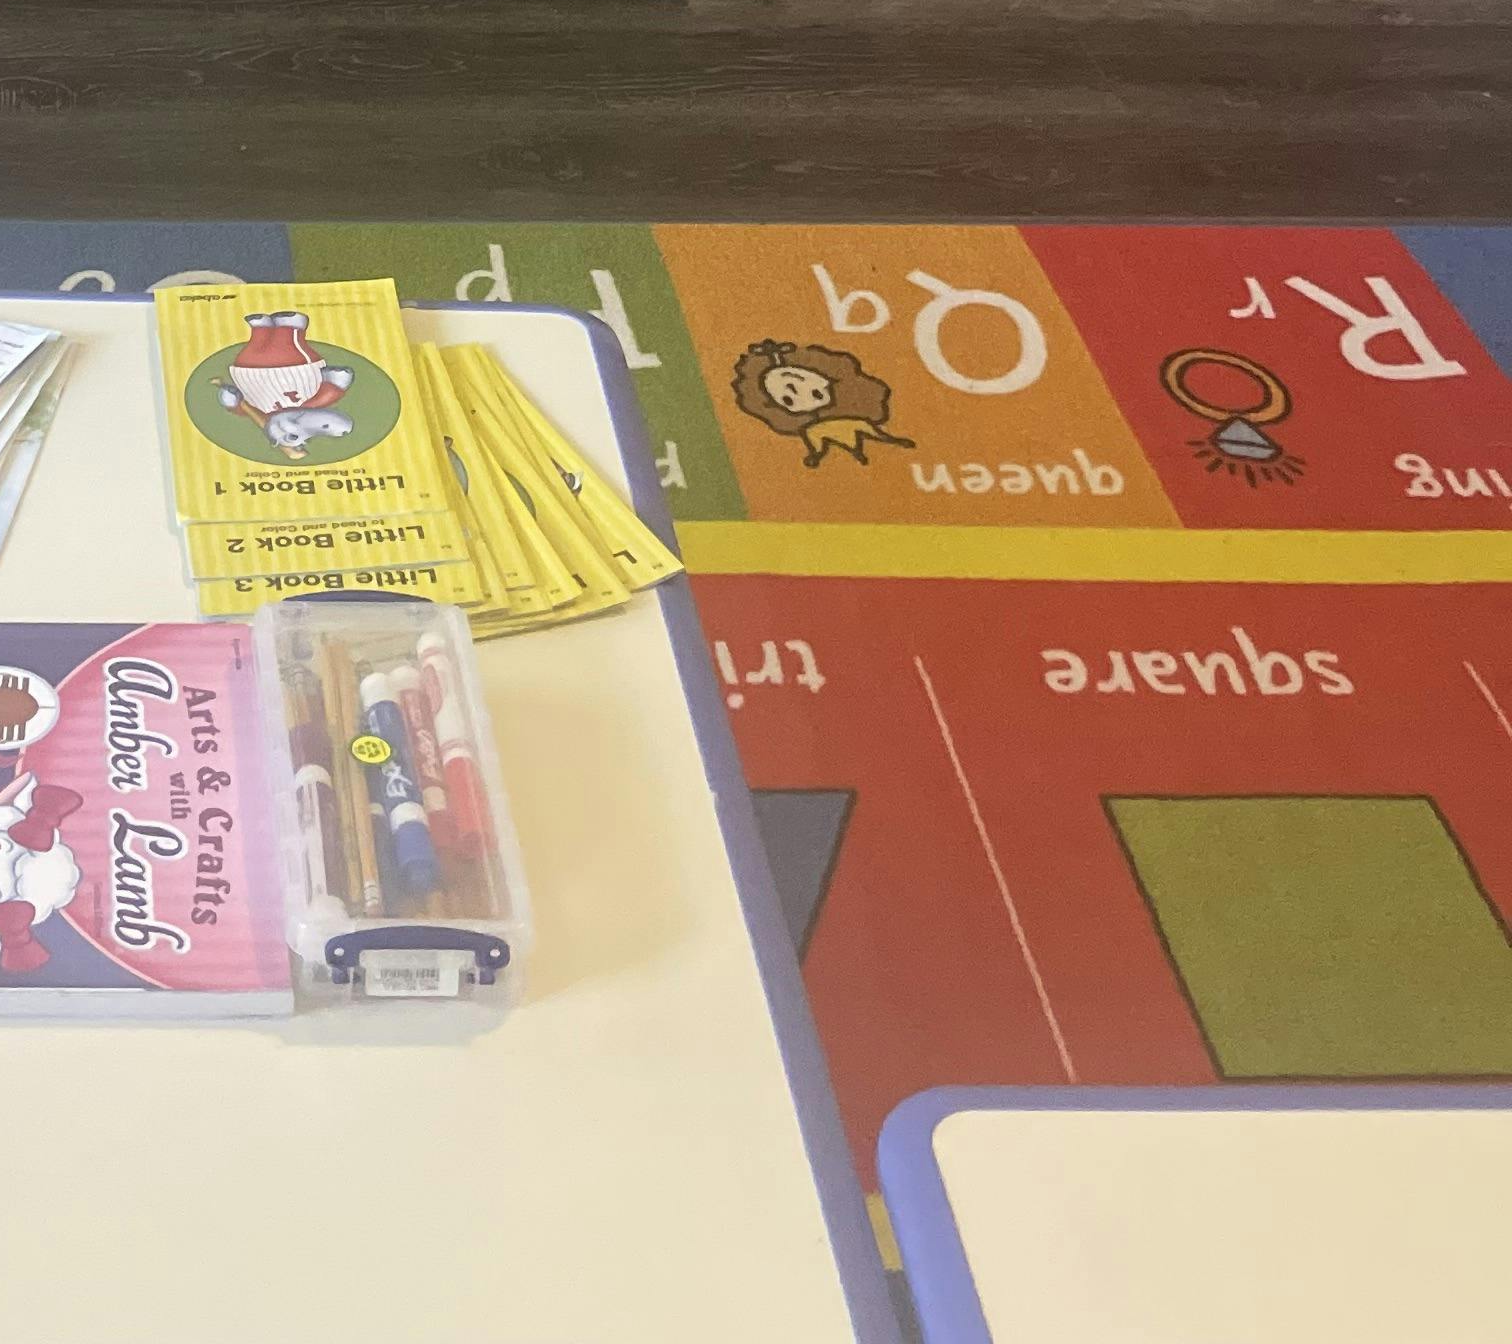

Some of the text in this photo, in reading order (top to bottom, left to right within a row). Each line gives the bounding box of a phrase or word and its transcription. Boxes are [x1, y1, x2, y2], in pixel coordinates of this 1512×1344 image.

[906, 270, 1048, 395] Q
[1230, 275, 1468, 382] R r
[214, 475, 404, 496] Little Book 1
[315, 469, 348, 477] Read
[912, 448, 1125, 498] queen
[1394, 453, 1512, 510] ing
[226, 526, 425, 553] Little Book 2
[261, 525, 298, 533] Color
[302, 523, 328, 531] and
[332, 520, 367, 529] Read
[235, 568, 437, 592] Little Book 3
[1045, 627, 1355, 697] square
[107, 661, 184, 949] Amber Lamb
[169, 771, 191, 820] with
[183, 686, 233, 925] Arts & Crafts
